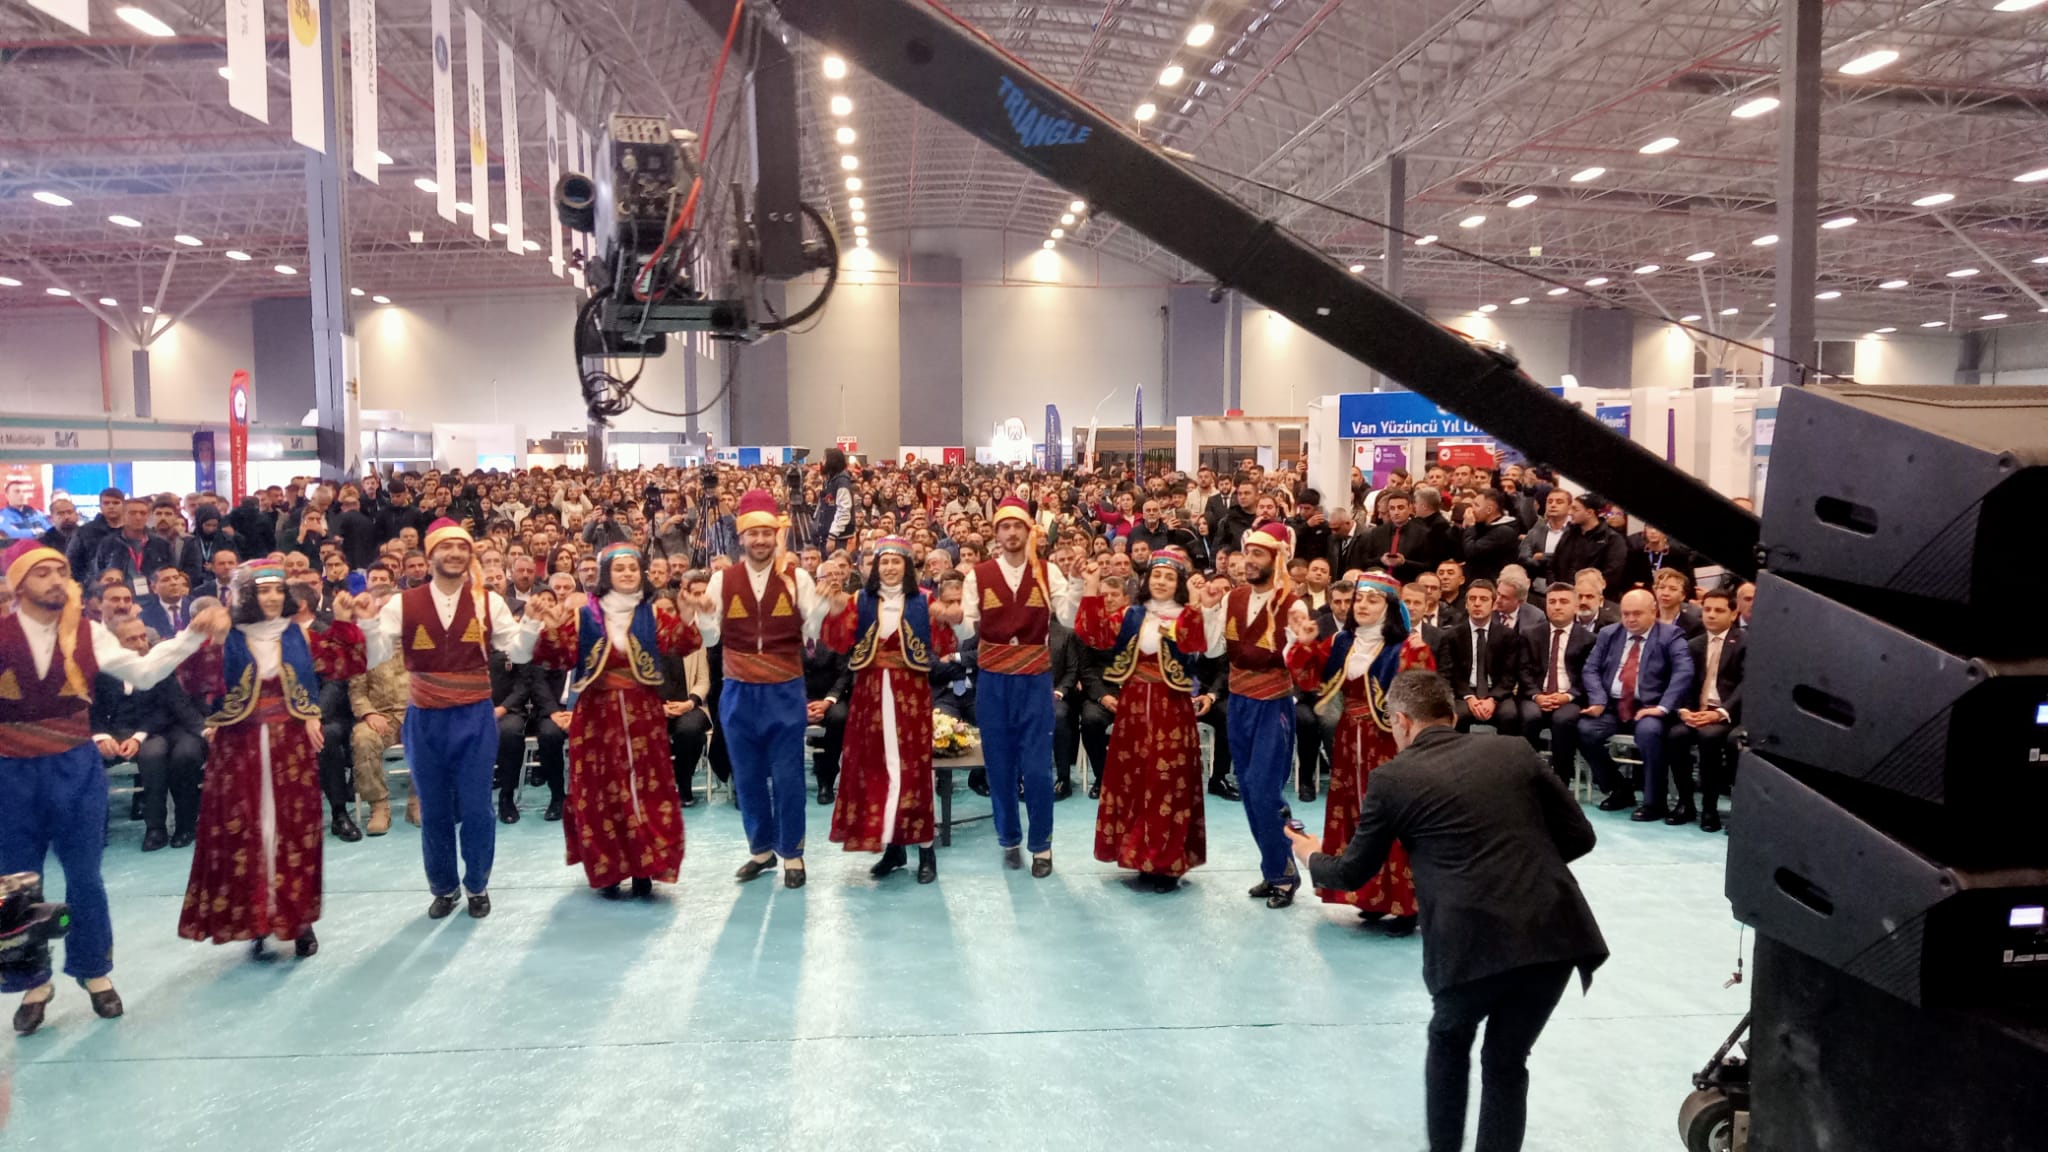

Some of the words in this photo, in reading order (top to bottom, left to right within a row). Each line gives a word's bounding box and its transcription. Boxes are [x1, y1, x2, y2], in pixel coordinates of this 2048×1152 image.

[998, 75, 1093, 148] TRIANGLE
[1351, 421, 1377, 435] Van
[1381, 420, 1438, 434] Yüzüncü
[1442, 420, 1460, 433] Yıl
[843, 442, 850, 452] 1
